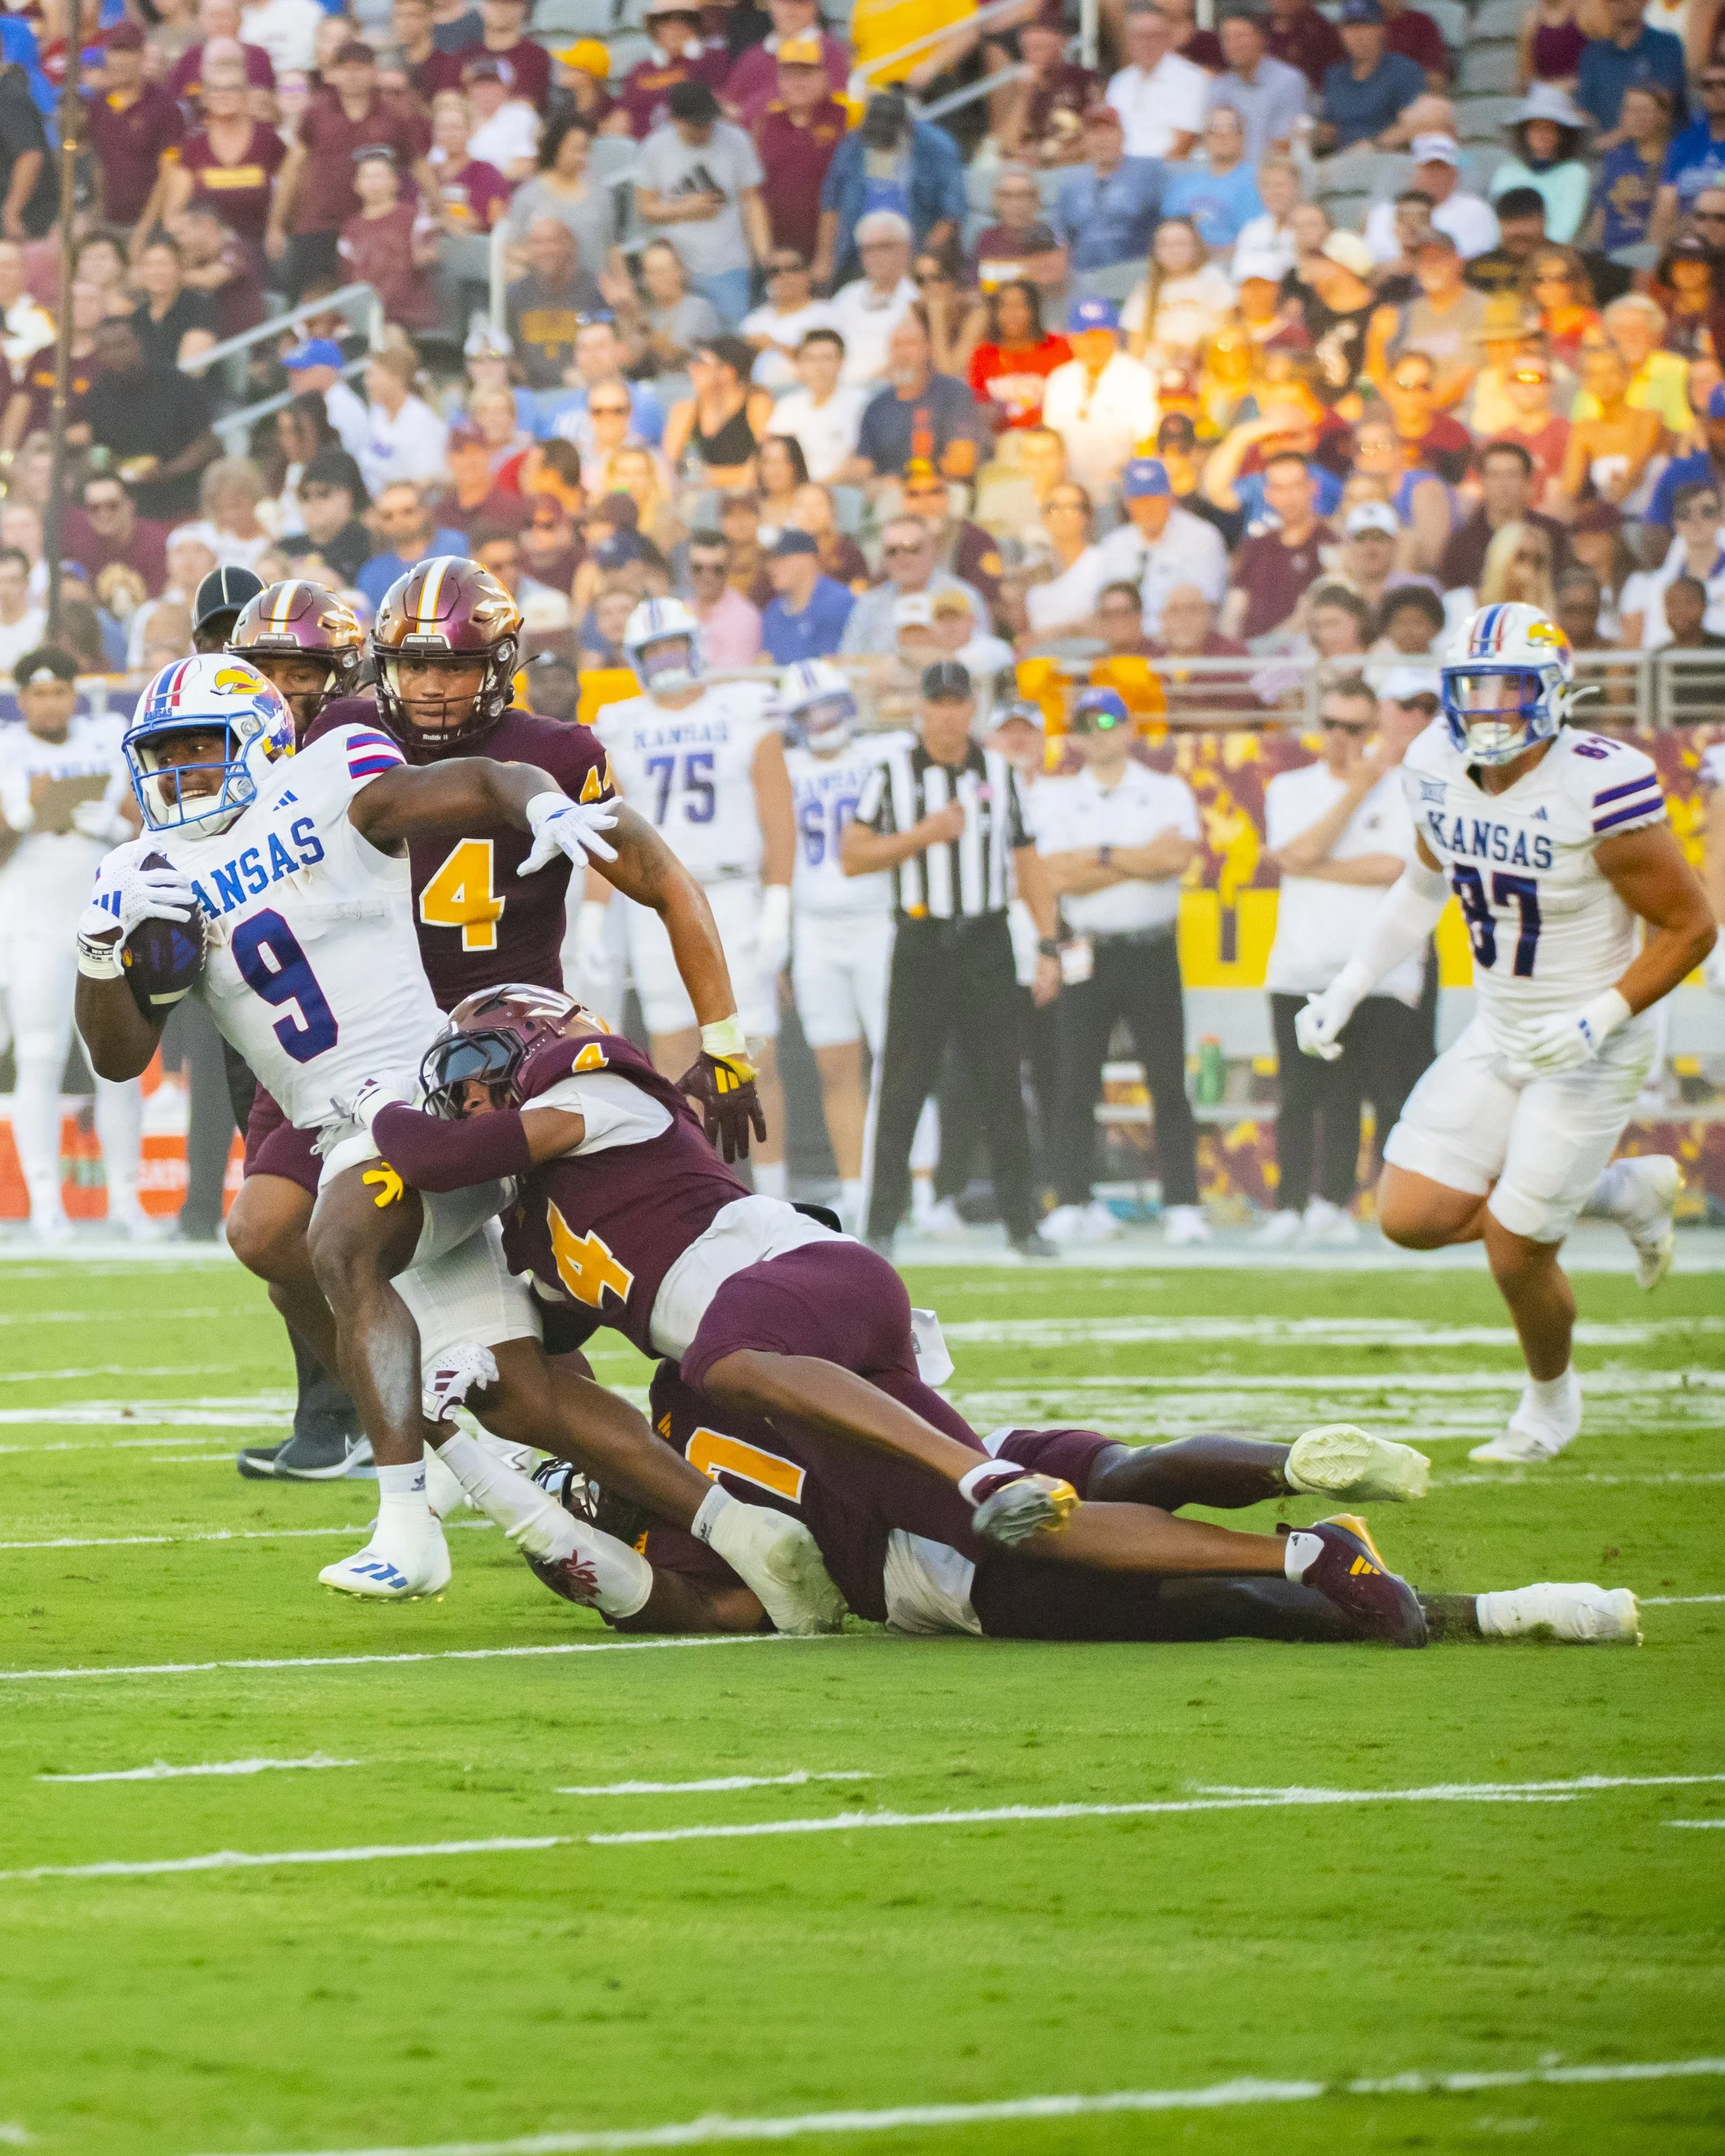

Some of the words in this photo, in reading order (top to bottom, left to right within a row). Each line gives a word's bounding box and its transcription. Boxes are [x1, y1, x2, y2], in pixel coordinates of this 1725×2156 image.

[633, 721, 729, 750] KANSAS
[646, 751, 716, 825] 75
[190, 817, 325, 920] ANSAS
[1428, 810, 1552, 869] KANSAS
[1452, 862, 1542, 979] 87
[231, 907, 338, 1064] 9
[571, 1042, 609, 1073] 4
[546, 1197, 635, 1309] 4
